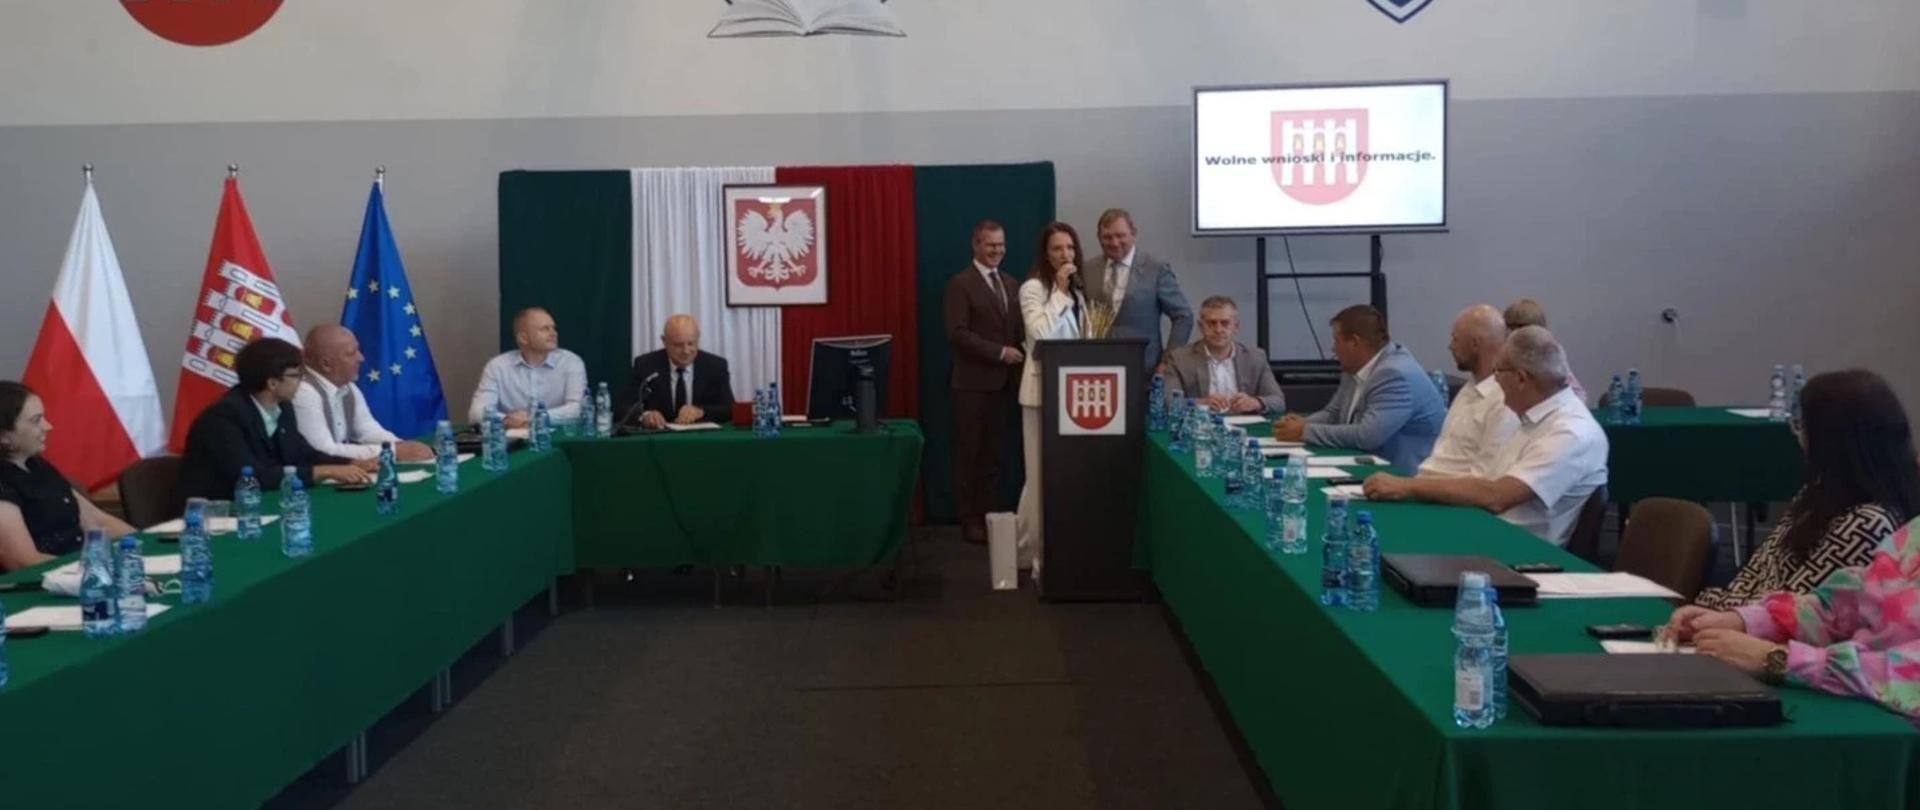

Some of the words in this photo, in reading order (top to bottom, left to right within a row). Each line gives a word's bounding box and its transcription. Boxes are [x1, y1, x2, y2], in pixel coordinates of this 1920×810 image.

[1205, 155, 1257, 166] Wolne
[1262, 152, 1325, 164] wnioski
[1330, 151, 1336, 163] i
[1340, 150, 1436, 163] informacje.
